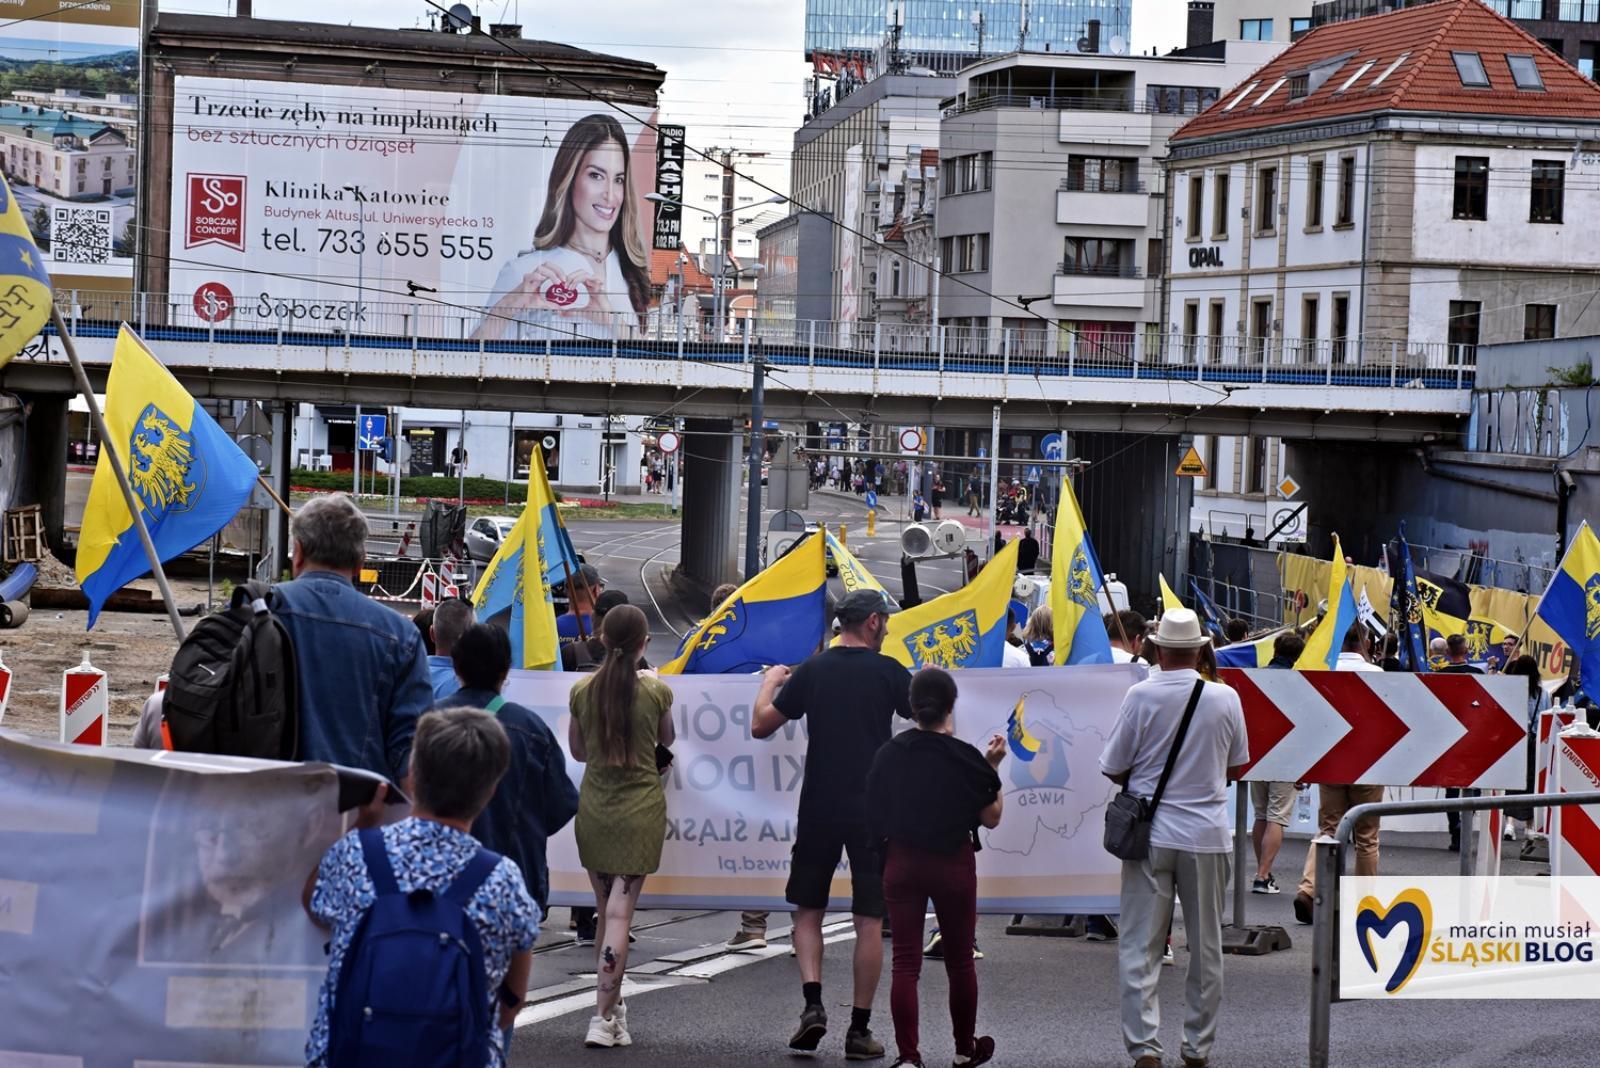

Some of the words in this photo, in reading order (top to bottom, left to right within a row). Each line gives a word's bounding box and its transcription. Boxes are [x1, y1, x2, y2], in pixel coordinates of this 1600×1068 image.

[188, 95, 273, 120] Trzecie
[280, 102, 330, 130] zęby
[338, 108, 364, 125] na
[373, 106, 498, 135] implantach
[187, 124, 222, 144] bez
[229, 128, 339, 152] sztucznych
[346, 133, 417, 156] dziąseł
[661, 127, 683, 137] RADIO
[265, 180, 344, 201] Klinika
[353, 184, 451, 207] Katowice
[195, 216, 238, 227] SOBCZAK
[264, 205, 322, 222] Budynek
[383, 211, 479, 229] Uniwersytecka
[482, 216, 495, 229] 13
[671, 220, 680, 233] FM
[195, 225, 237, 236] CONCEPT
[668, 235, 678, 248] FM
[261, 227, 306, 252] tel.
[317, 227, 366, 254] 733
[376, 231, 429, 258] 655
[440, 235, 494, 260] 555
[1189, 246, 1224, 268] OPAL
[1562, 746, 1594, 780] UNISTOP
